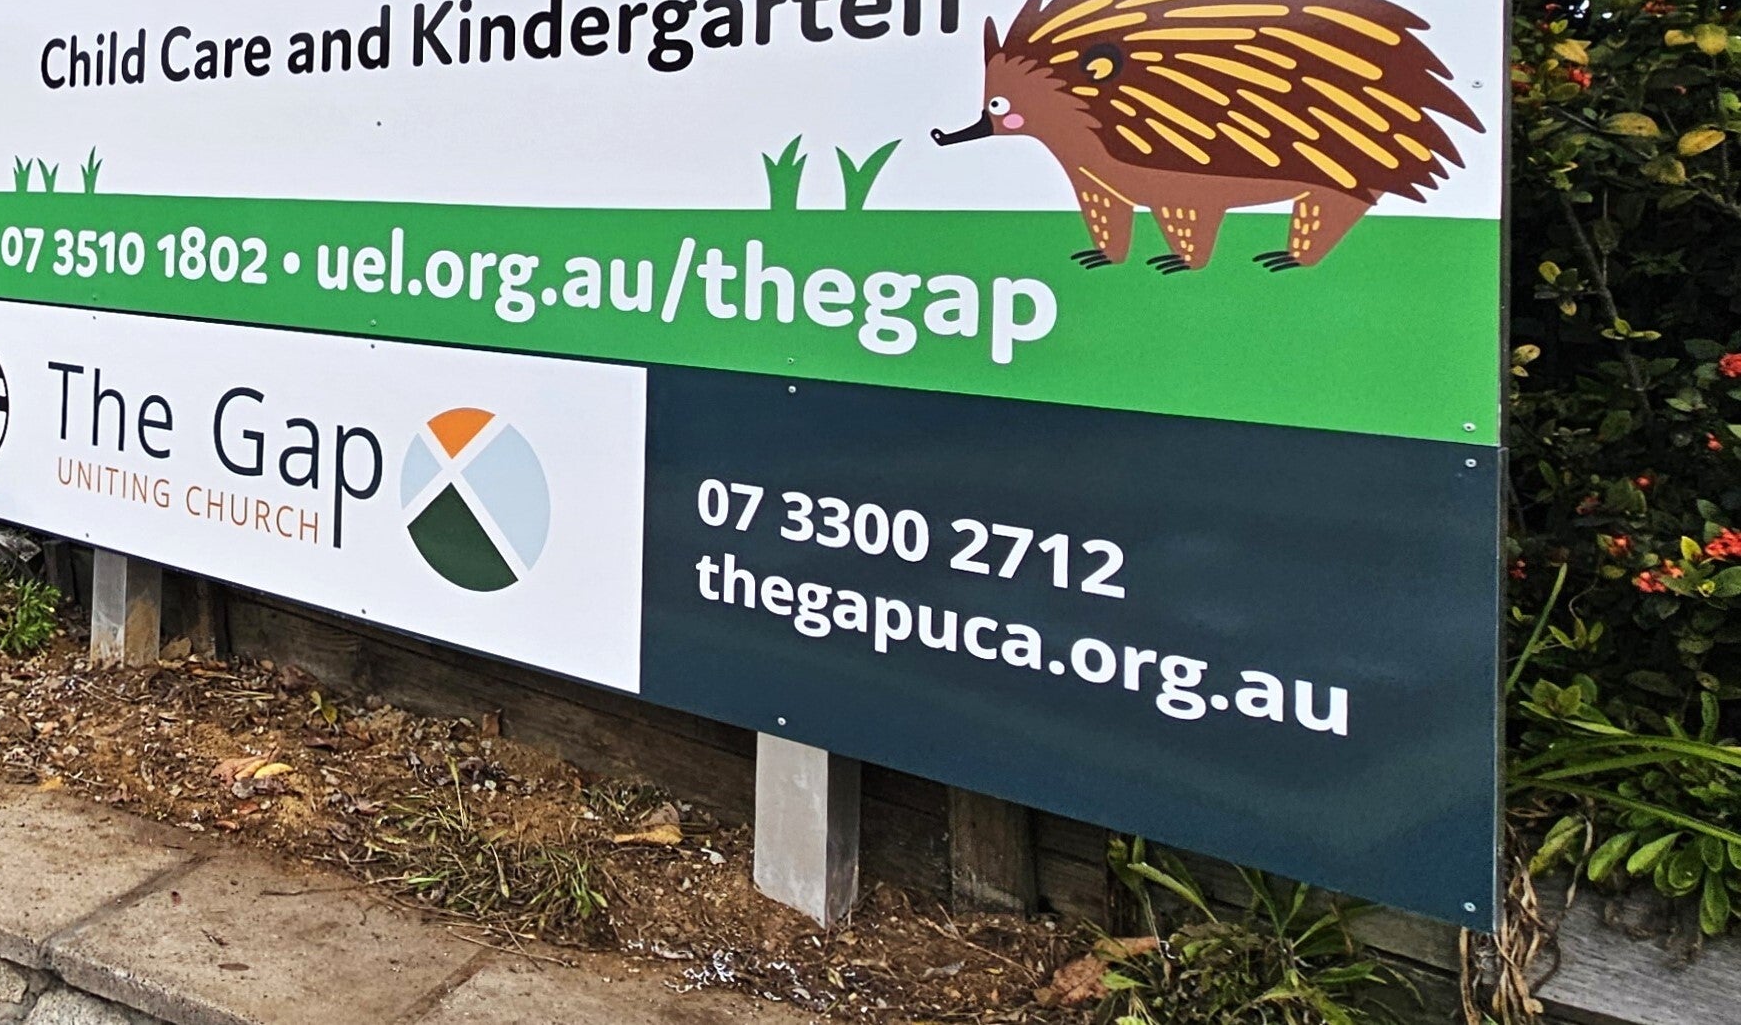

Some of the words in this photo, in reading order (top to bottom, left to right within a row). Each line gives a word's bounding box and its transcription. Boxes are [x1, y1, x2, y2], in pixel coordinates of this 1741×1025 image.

[40, 28, 147, 90] Child
[160, 25, 273, 82] Care
[287, 4, 392, 75] and
[0, 226, 46, 274] 07
[51, 228, 146, 278] 3510
[156, 226, 270, 285] 1802
[315, 227, 1059, 365] uel.org.au/thegap
[47, 360, 174, 459] The
[212, 386, 384, 550] Gap
[57, 456, 172, 510] UNITING
[185, 485, 320, 545] CHURCH
[697, 478, 765, 533] 07
[778, 491, 930, 564] 3300
[949, 518, 1127, 600] 2712
[695, 553, 1351, 737] thegapuca.org.au
